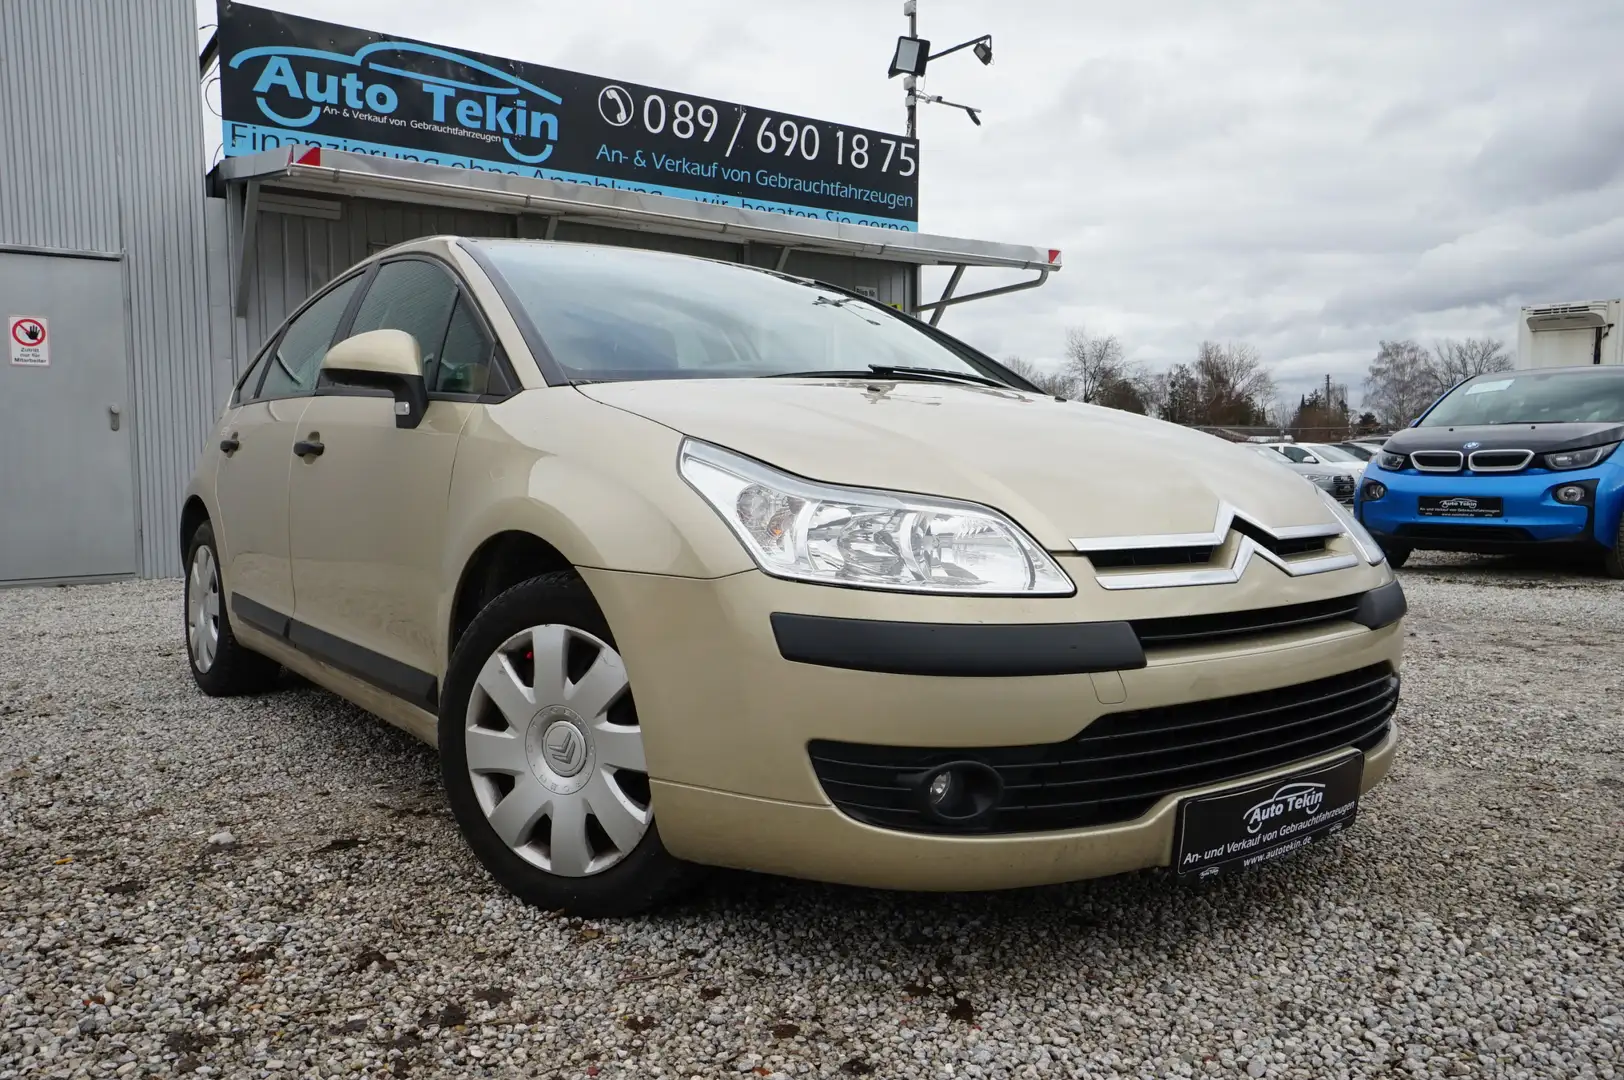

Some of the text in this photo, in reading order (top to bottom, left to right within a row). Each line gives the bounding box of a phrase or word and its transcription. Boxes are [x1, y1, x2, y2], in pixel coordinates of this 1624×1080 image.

[252, 56, 558, 141] Auto Tekin
[323, 105, 501, 143] An- & Verkauf von Gebrauchtfahrzeugen
[643, 94, 916, 177] 089 / 690 18 75
[596, 144, 629, 164] An-
[633, 150, 647, 168] &
[652, 152, 718, 178] Verkauf
[721, 167, 751, 183] von
[755, 169, 913, 210] Gebrauchtfahrzeugen
[1183, 852, 1202, 865] An-
[1204, 844, 1225, 860] und
[1227, 833, 1262, 853] Verkauf
[1262, 829, 1278, 842] von
[1279, 801, 1355, 836] Gebrauchtfahrzeugen
[1249, 791, 1323, 825] Auto Tekin
[1243, 836, 1312, 867] www.autotekin.de
